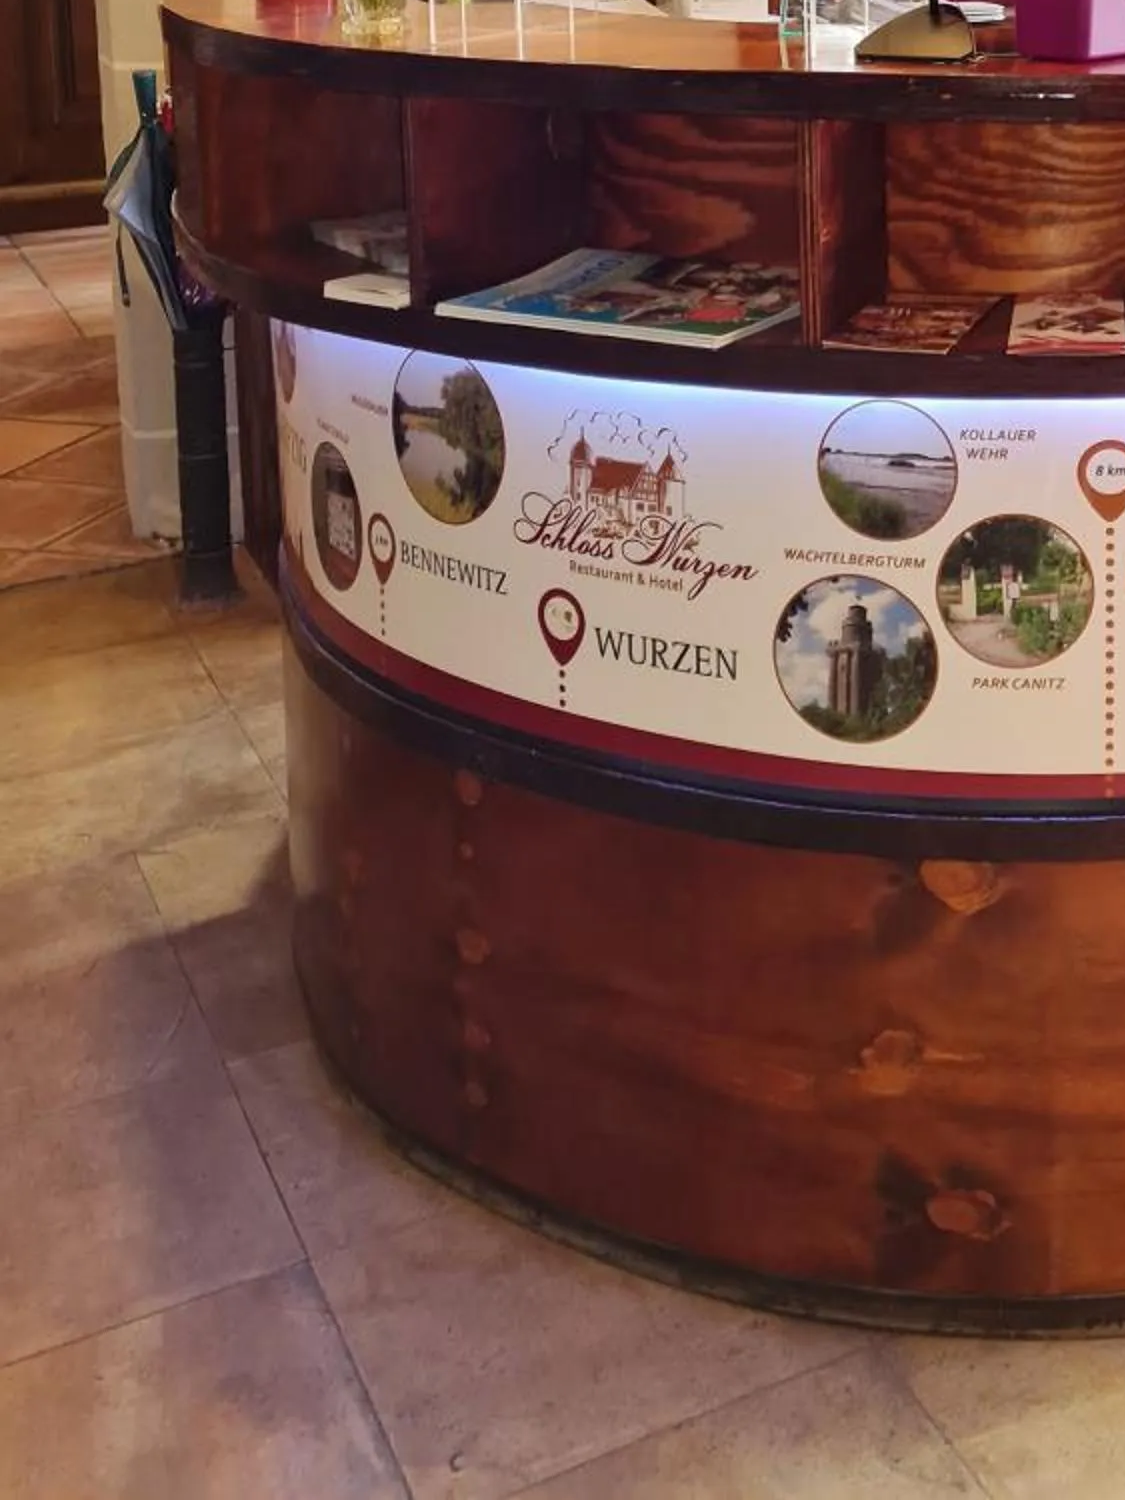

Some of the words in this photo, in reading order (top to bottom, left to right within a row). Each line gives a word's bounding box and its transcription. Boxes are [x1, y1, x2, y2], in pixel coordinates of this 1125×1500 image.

[960, 428, 1036, 443] KOLLAUER
[966, 446, 1009, 461] WEHR
[513, 491, 616, 560] Schloss
[621, 514, 759, 601] Wurzen
[783, 547, 926, 570] WACHTELBERGTURM
[399, 540, 509, 596] BENNEWITZ
[569, 559, 633, 584] Restaurant
[636, 572, 645, 585] &
[649, 575, 684, 592] Hotel
[594, 627, 738, 682] WURZEN
[972, 677, 1009, 690] PARK
[1011, 677, 1066, 691] CANITZ
